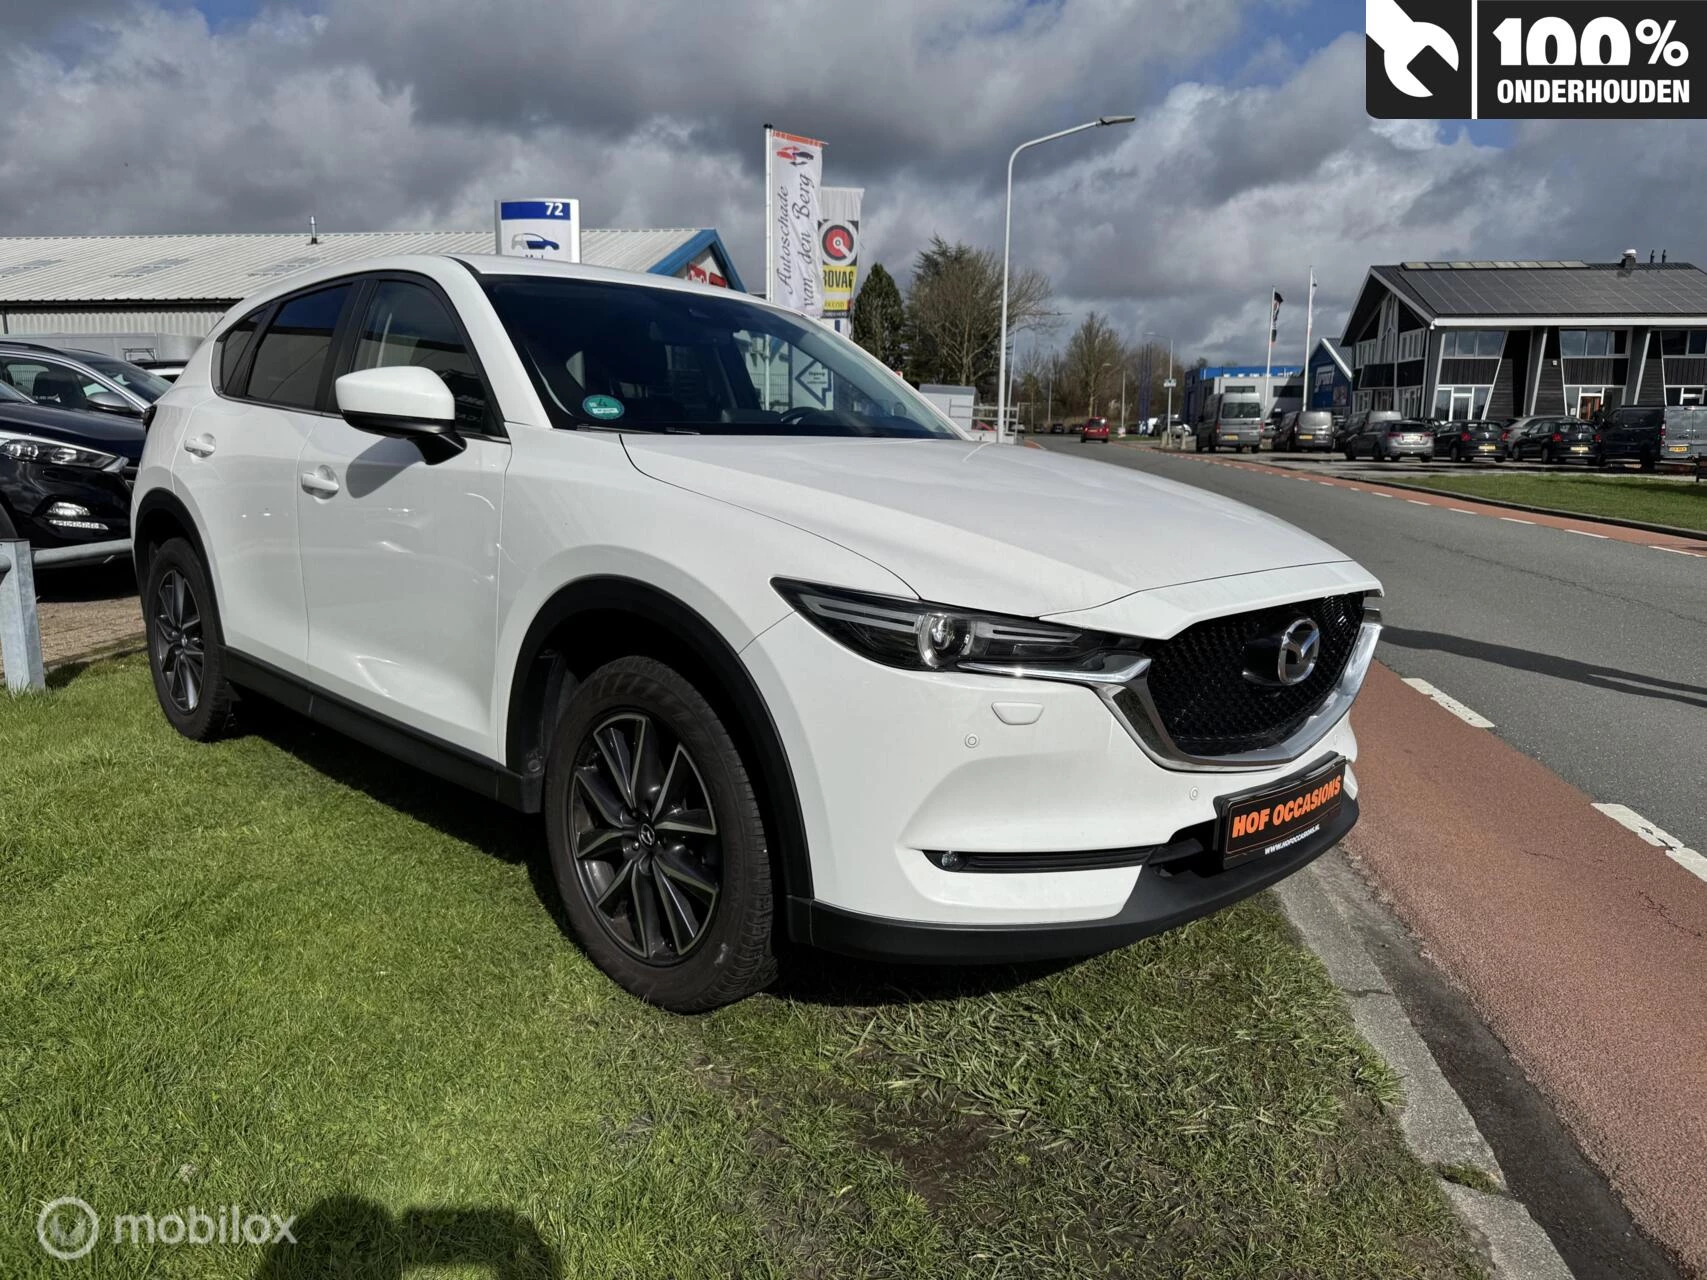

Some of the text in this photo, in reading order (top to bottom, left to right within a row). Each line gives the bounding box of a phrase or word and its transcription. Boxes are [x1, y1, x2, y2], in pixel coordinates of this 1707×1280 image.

[545, 202, 564, 216] 72
[776, 186, 793, 295] Autoschade
[792, 173, 815, 308] van den Berg
[1232, 775, 1341, 838] HOF OCCASIONS
